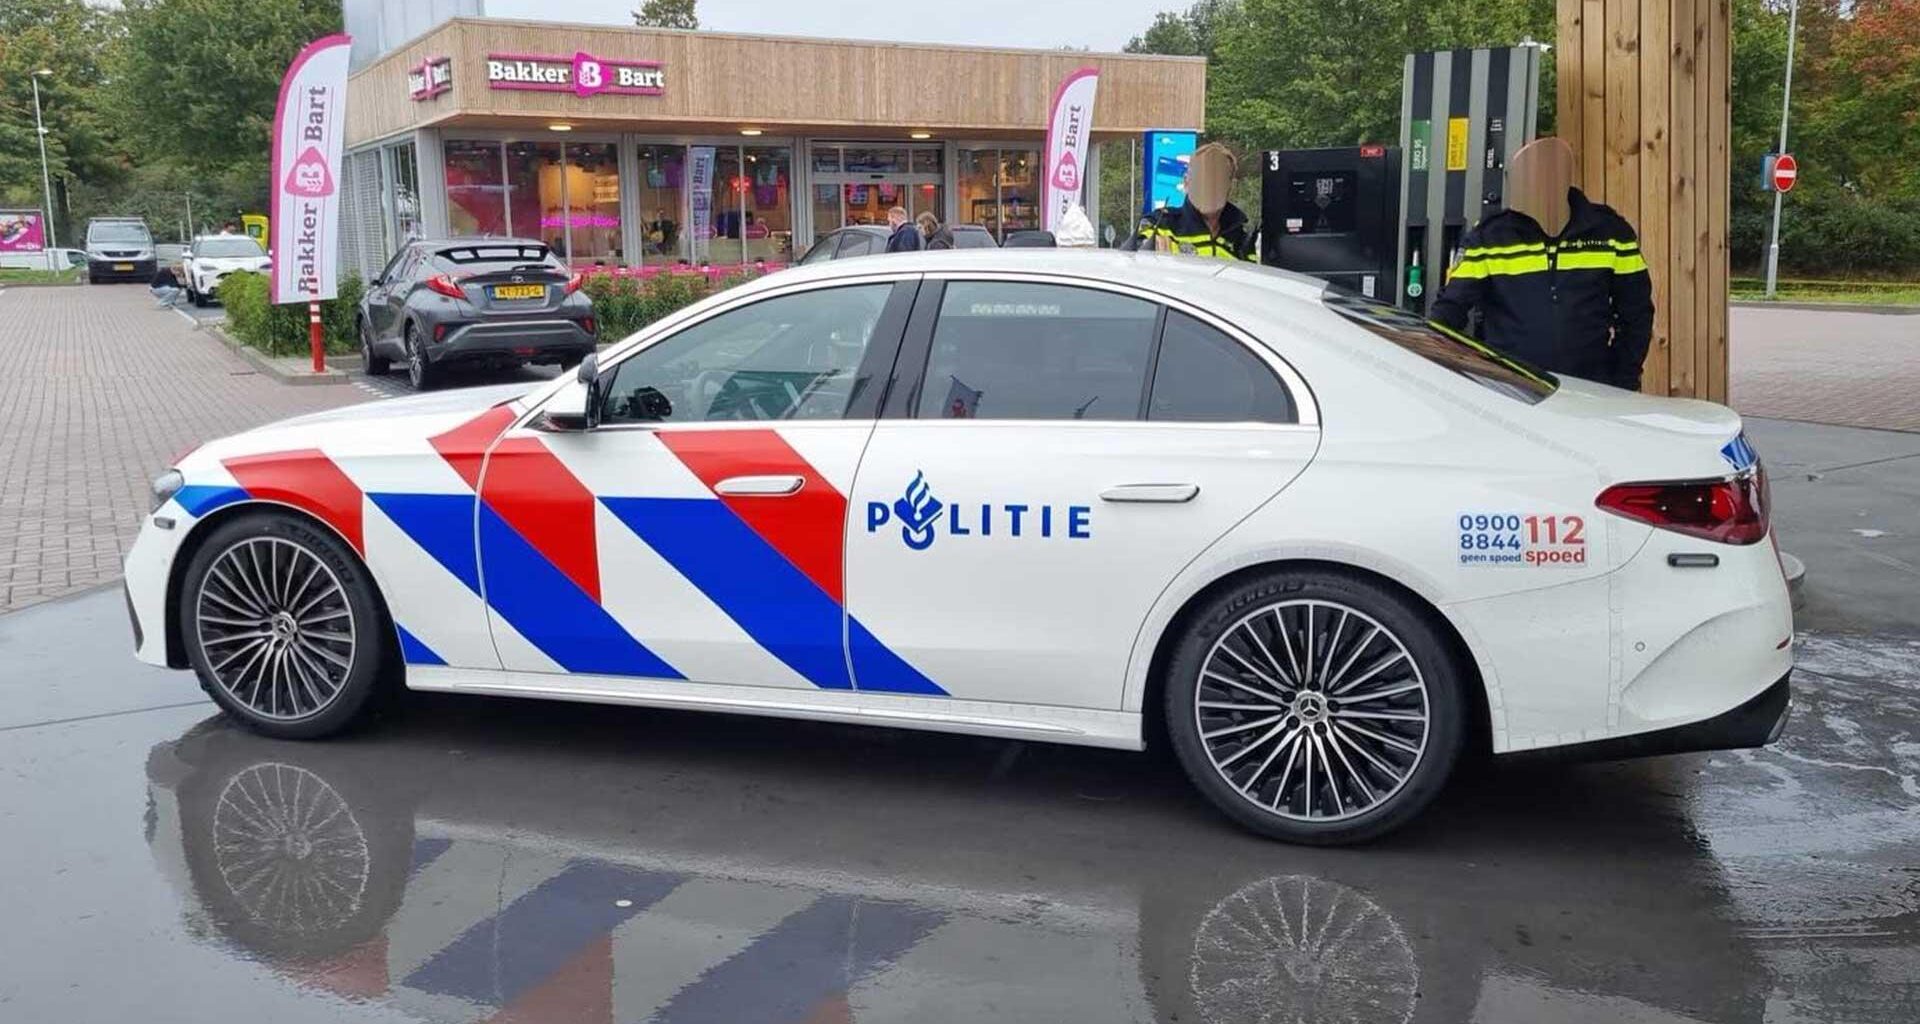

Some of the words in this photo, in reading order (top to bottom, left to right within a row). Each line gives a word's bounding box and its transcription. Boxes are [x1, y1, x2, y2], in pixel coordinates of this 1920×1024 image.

[488, 61, 568, 83] Bakker
[618, 67, 665, 88] Bart
[304, 85, 326, 142] Bart
[1065, 105, 1081, 149] Bart
[1269, 155, 1280, 171] 3
[867, 485, 1091, 550] POLITIE
[1459, 515, 1520, 531] 0900
[1524, 516, 1585, 544] 112
[1460, 534, 1521, 550] 8844
[1460, 553, 1487, 563] geen
[1489, 552, 1521, 564] spoed
[1525, 548, 1585, 566] spoed
